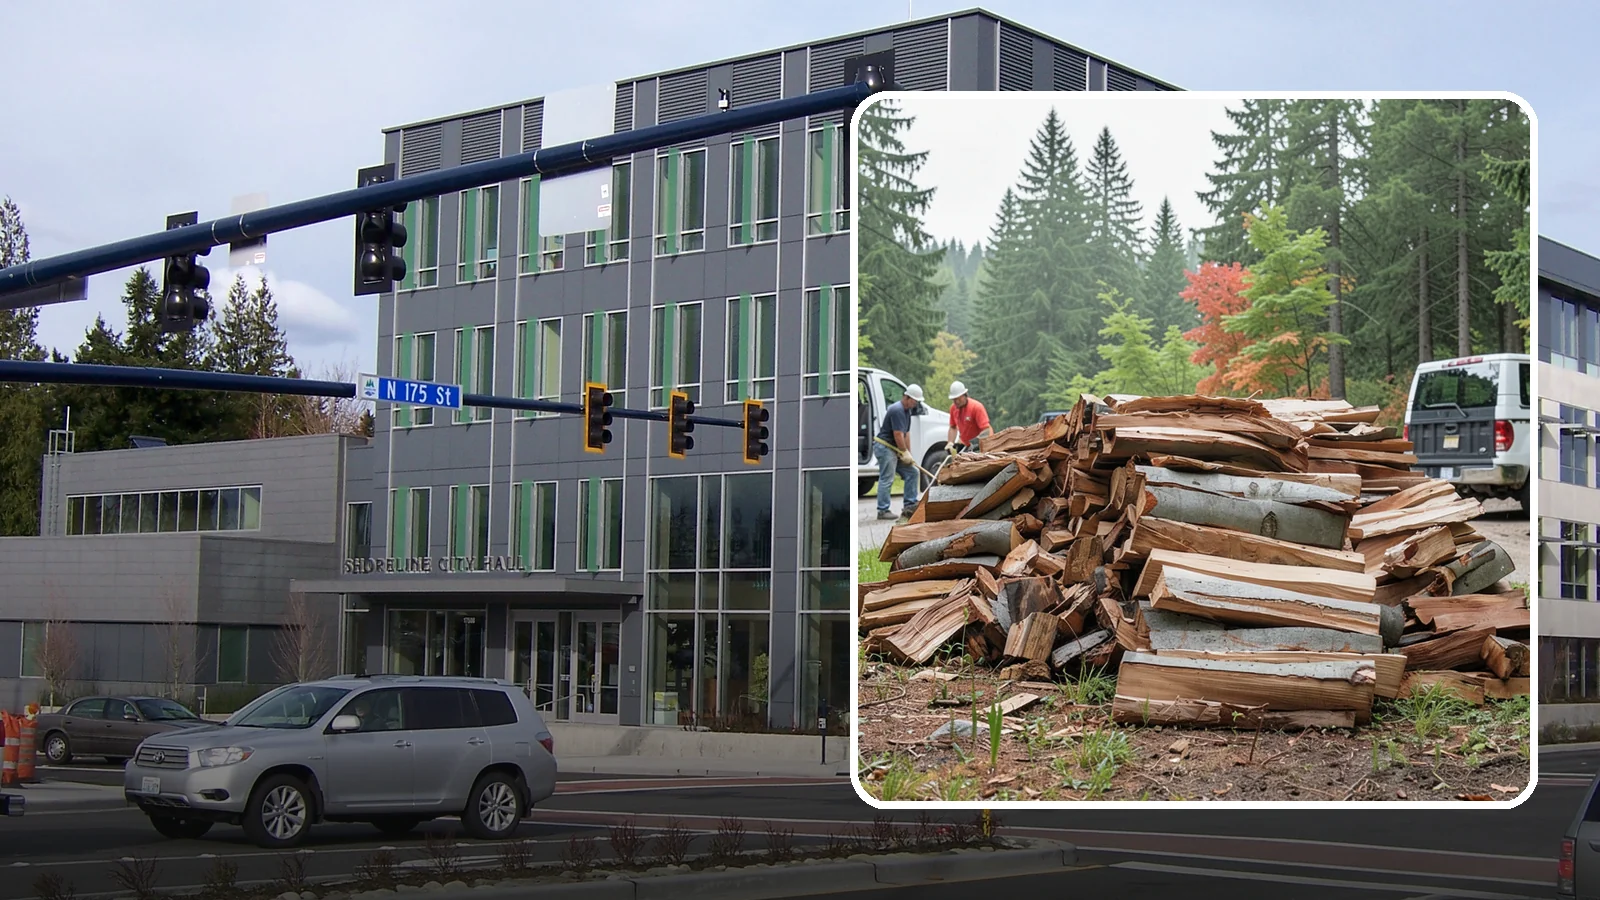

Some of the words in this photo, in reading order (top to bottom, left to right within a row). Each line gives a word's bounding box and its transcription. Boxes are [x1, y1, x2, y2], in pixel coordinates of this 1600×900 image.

[387, 381, 396, 400] N
[405, 383, 427, 403] 175
[436, 386, 451, 406] St
[343, 557, 432, 575] SHORELINE
[438, 556, 476, 572] CITY
[483, 555, 525, 572] HALL
